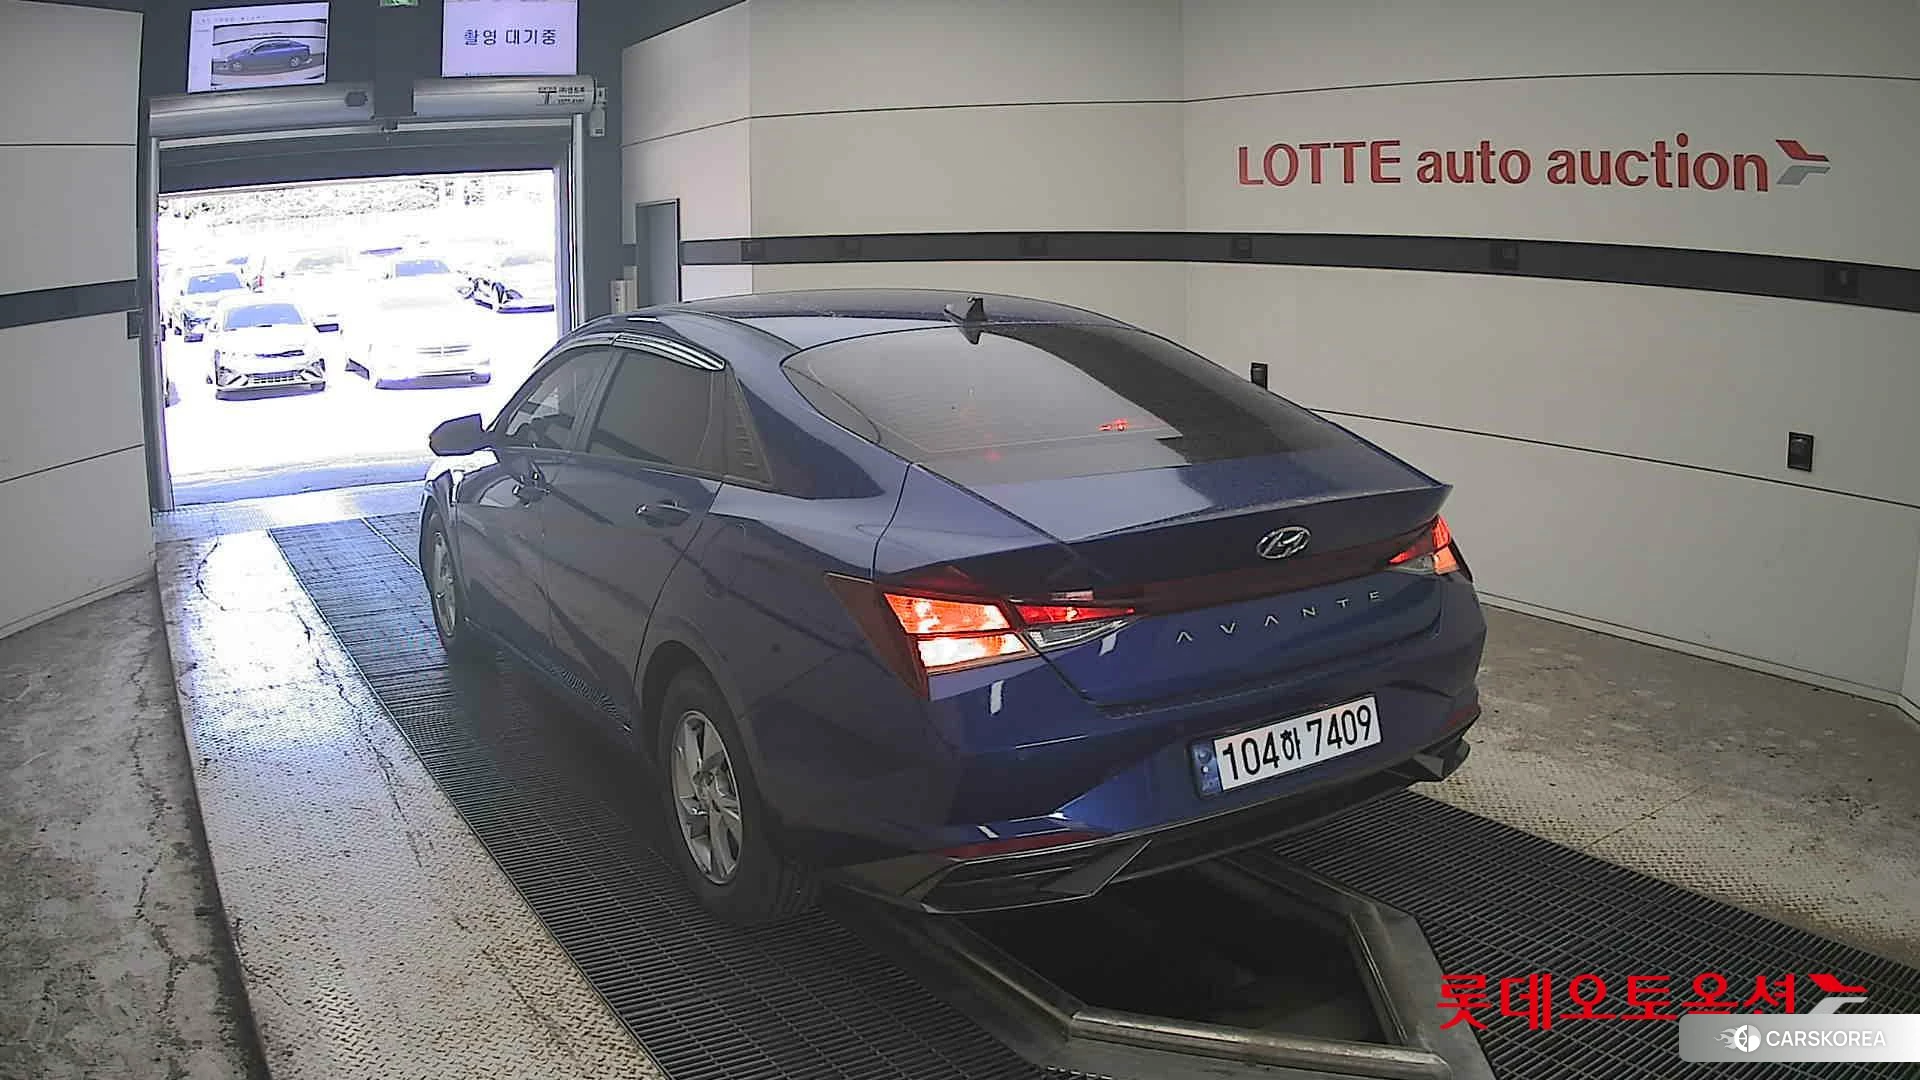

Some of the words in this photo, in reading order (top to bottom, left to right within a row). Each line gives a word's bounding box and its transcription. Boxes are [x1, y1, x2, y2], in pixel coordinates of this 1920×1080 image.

[505, 28, 557, 46] 대기중
[1238, 140, 1401, 187] LOTTE
[1417, 140, 1532, 184] auto
[1547, 133, 1769, 193] auction
[1176, 591, 1381, 643] AVANTE
[1222, 727, 1302, 780] 104하
[1306, 704, 1373, 756] 7409
